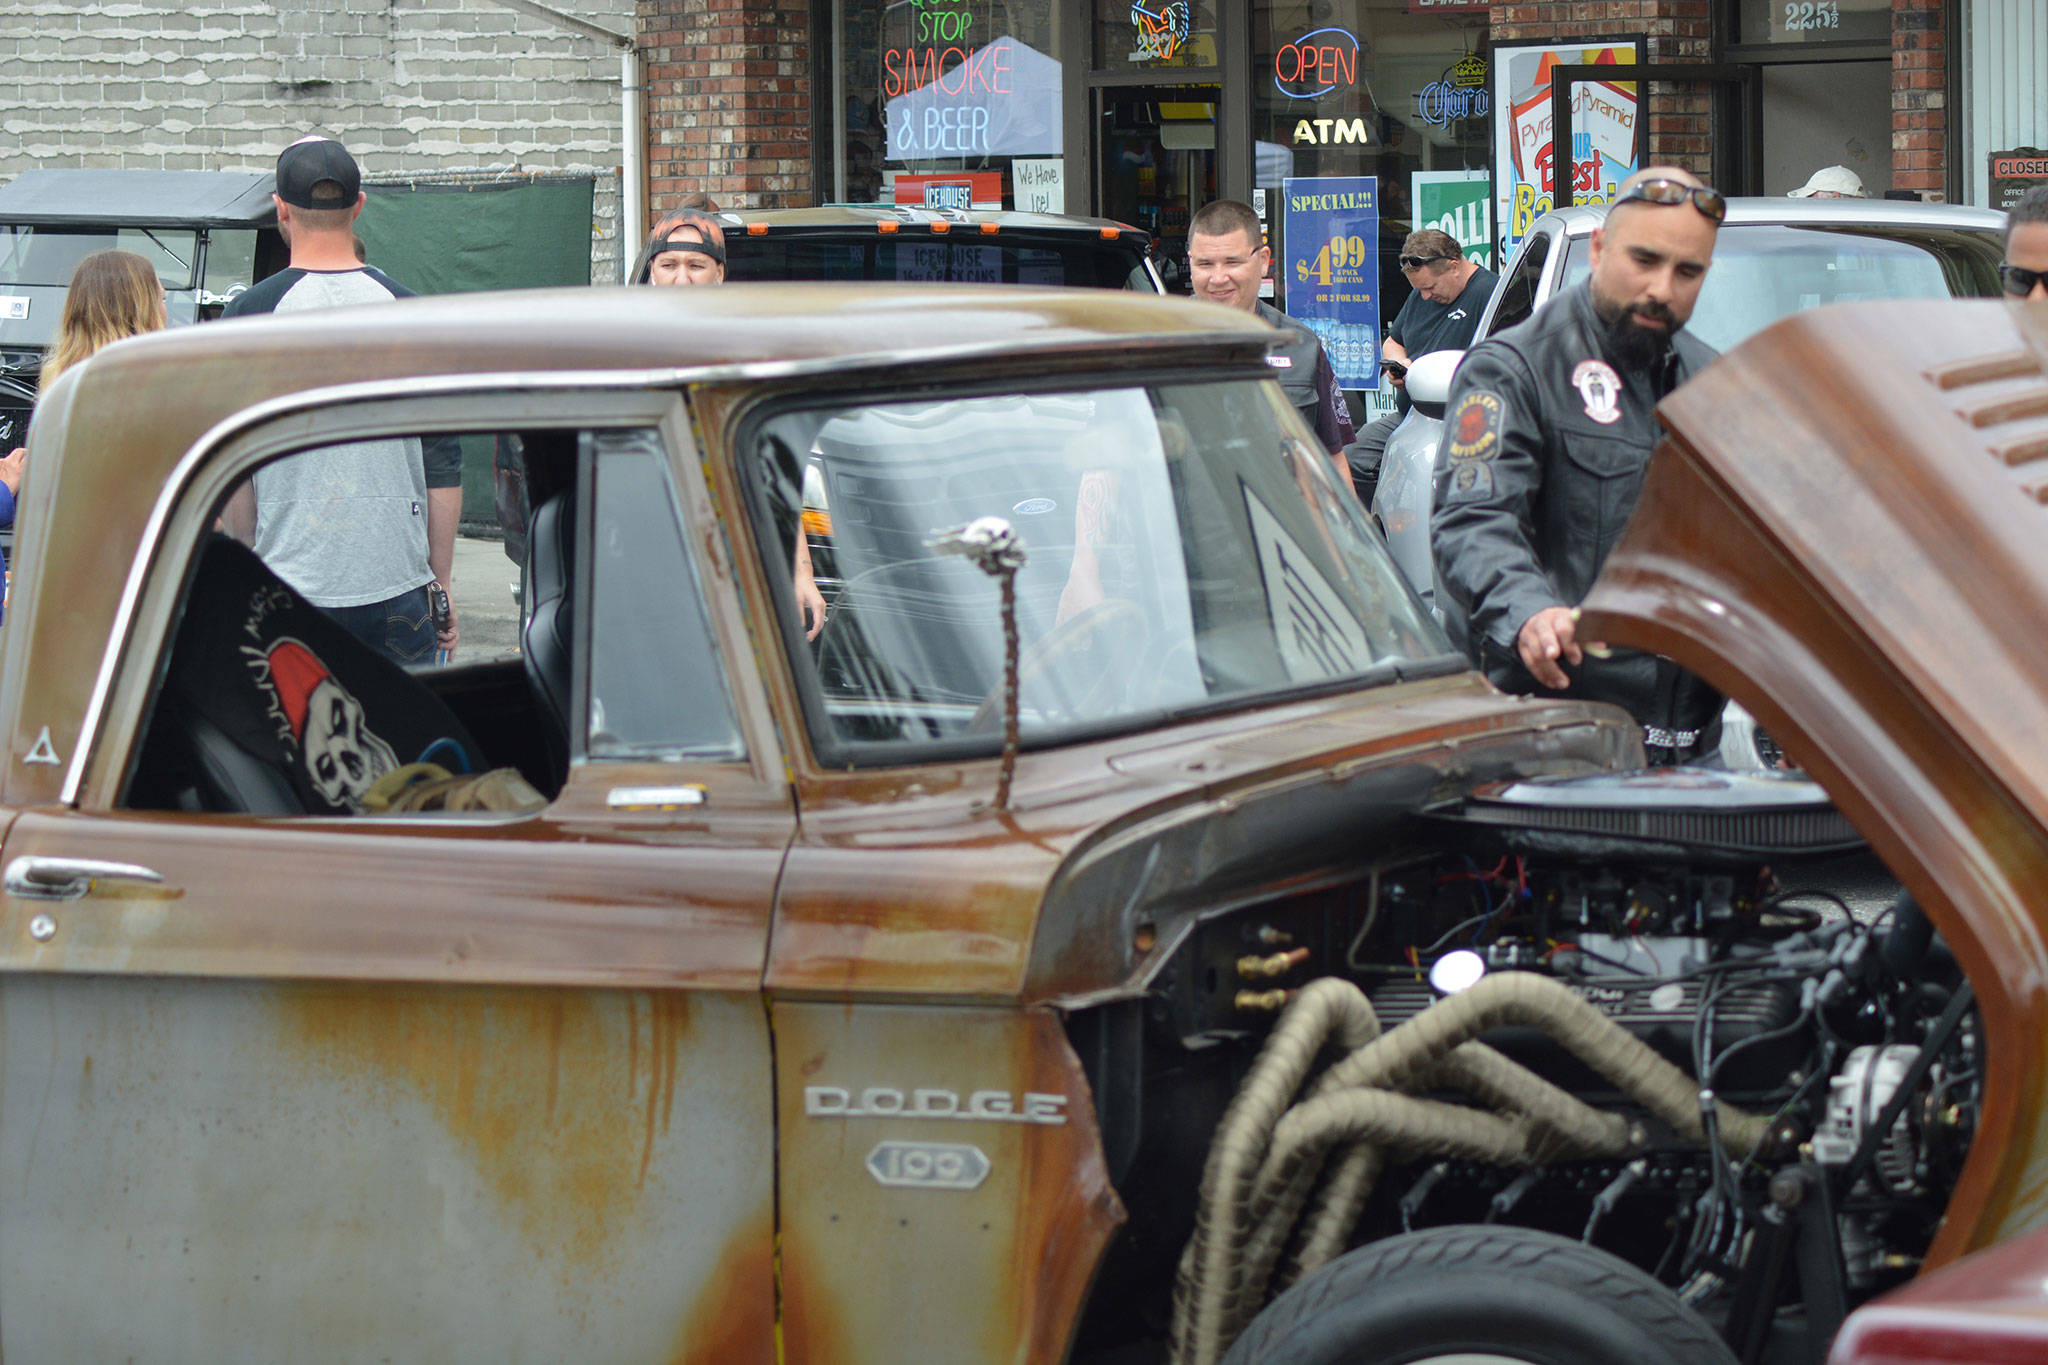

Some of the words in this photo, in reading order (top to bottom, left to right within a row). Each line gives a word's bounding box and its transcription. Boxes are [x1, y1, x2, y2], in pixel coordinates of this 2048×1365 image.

[918, 11, 972, 42] STOP
[1137, 33, 1172, 57] 227
[885, 46, 1012, 96] SMOKE
[1276, 44, 1357, 85] OPEN
[1582, 86, 1635, 129] Pyramid
[897, 108, 919, 150] &
[924, 106, 990, 150] BEER
[1293, 118, 1368, 144] ATM
[1018, 164, 1033, 185] We
[1035, 164, 1060, 186] Have
[925, 186, 971, 209] ICEHOUSE
[1291, 192, 1372, 212] SPECIAL!!!
[2004, 188, 2024, 196] OFFICE
[1316, 294, 1328, 302] OR
[1336, 294, 1351, 302] FOR
[805, 1086, 1067, 1125] DODGE
[887, 1150, 964, 1179] 100
